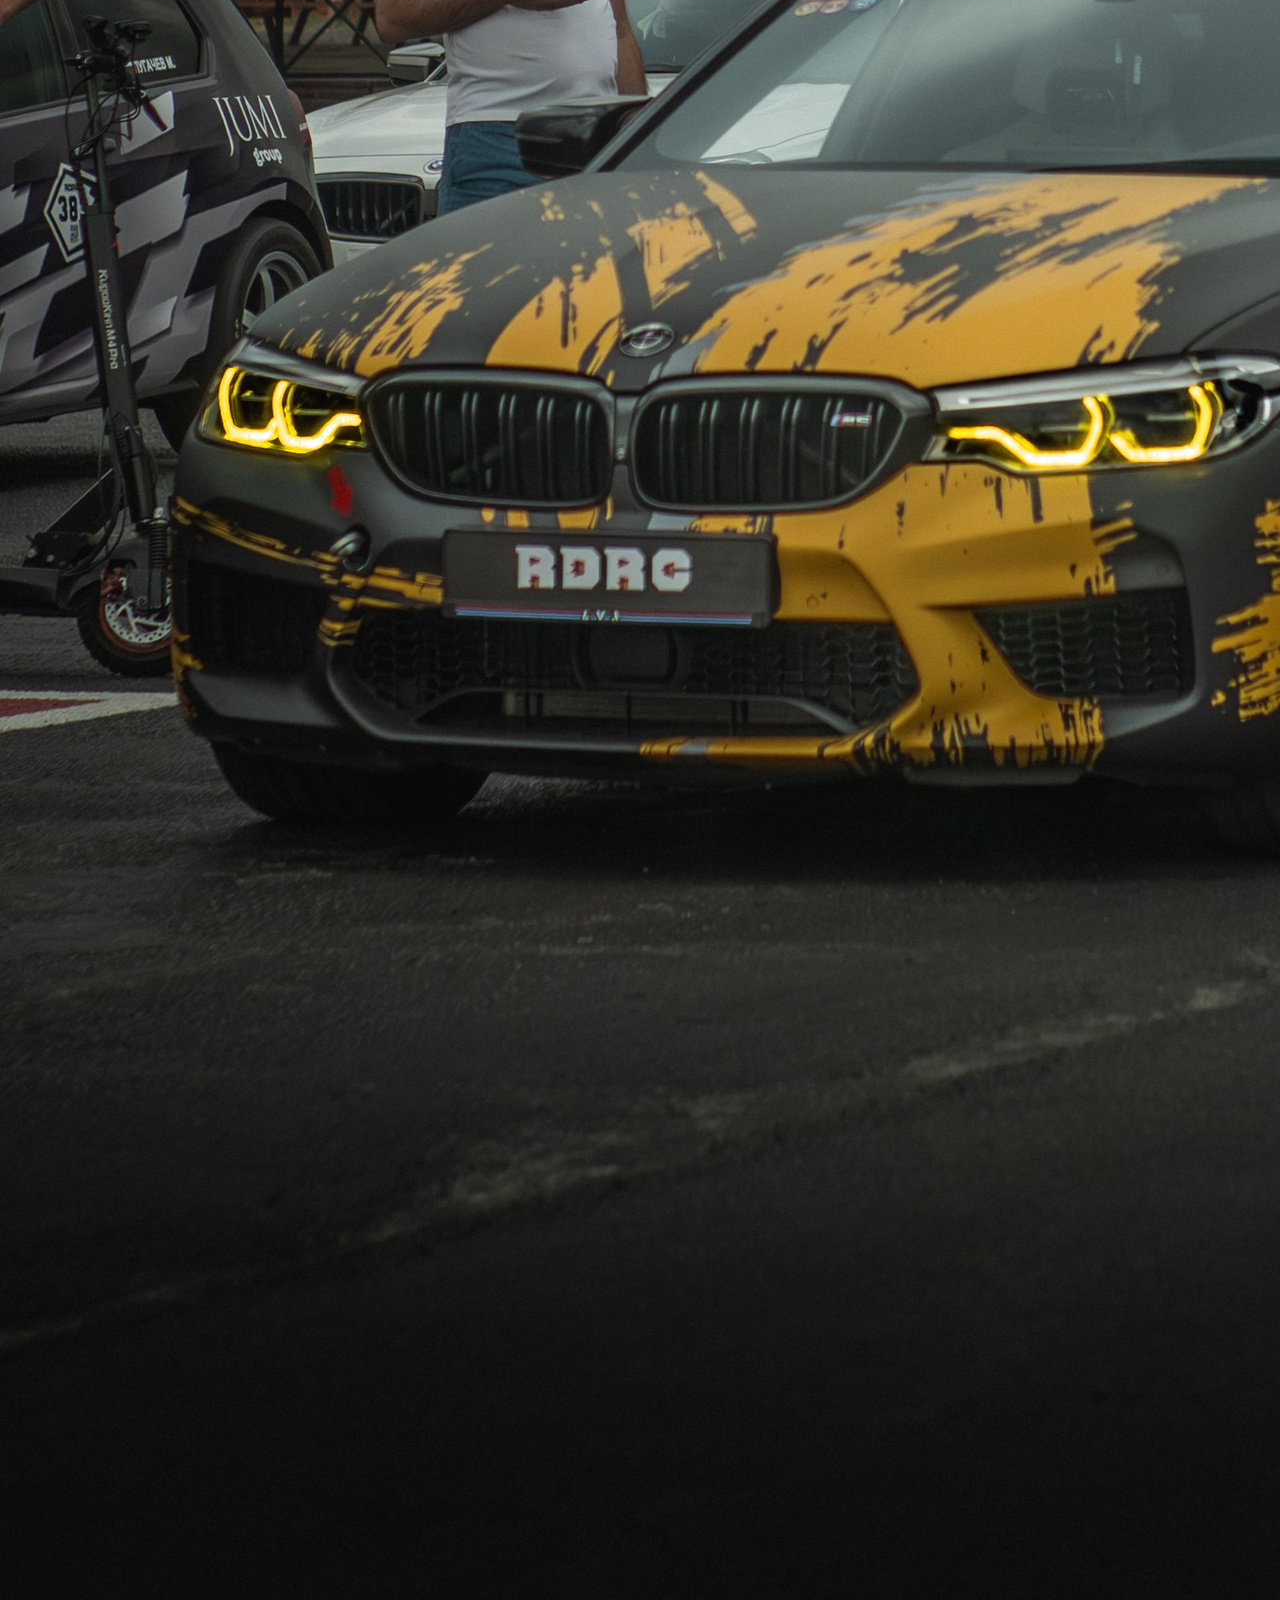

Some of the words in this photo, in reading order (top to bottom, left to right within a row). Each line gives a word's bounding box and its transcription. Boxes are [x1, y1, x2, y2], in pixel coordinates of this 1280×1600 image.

[212, 94, 287, 157] JUMI
[253, 147, 283, 167] group
[58, 195, 78, 222] 38
[513, 544, 694, 592] RDRC
